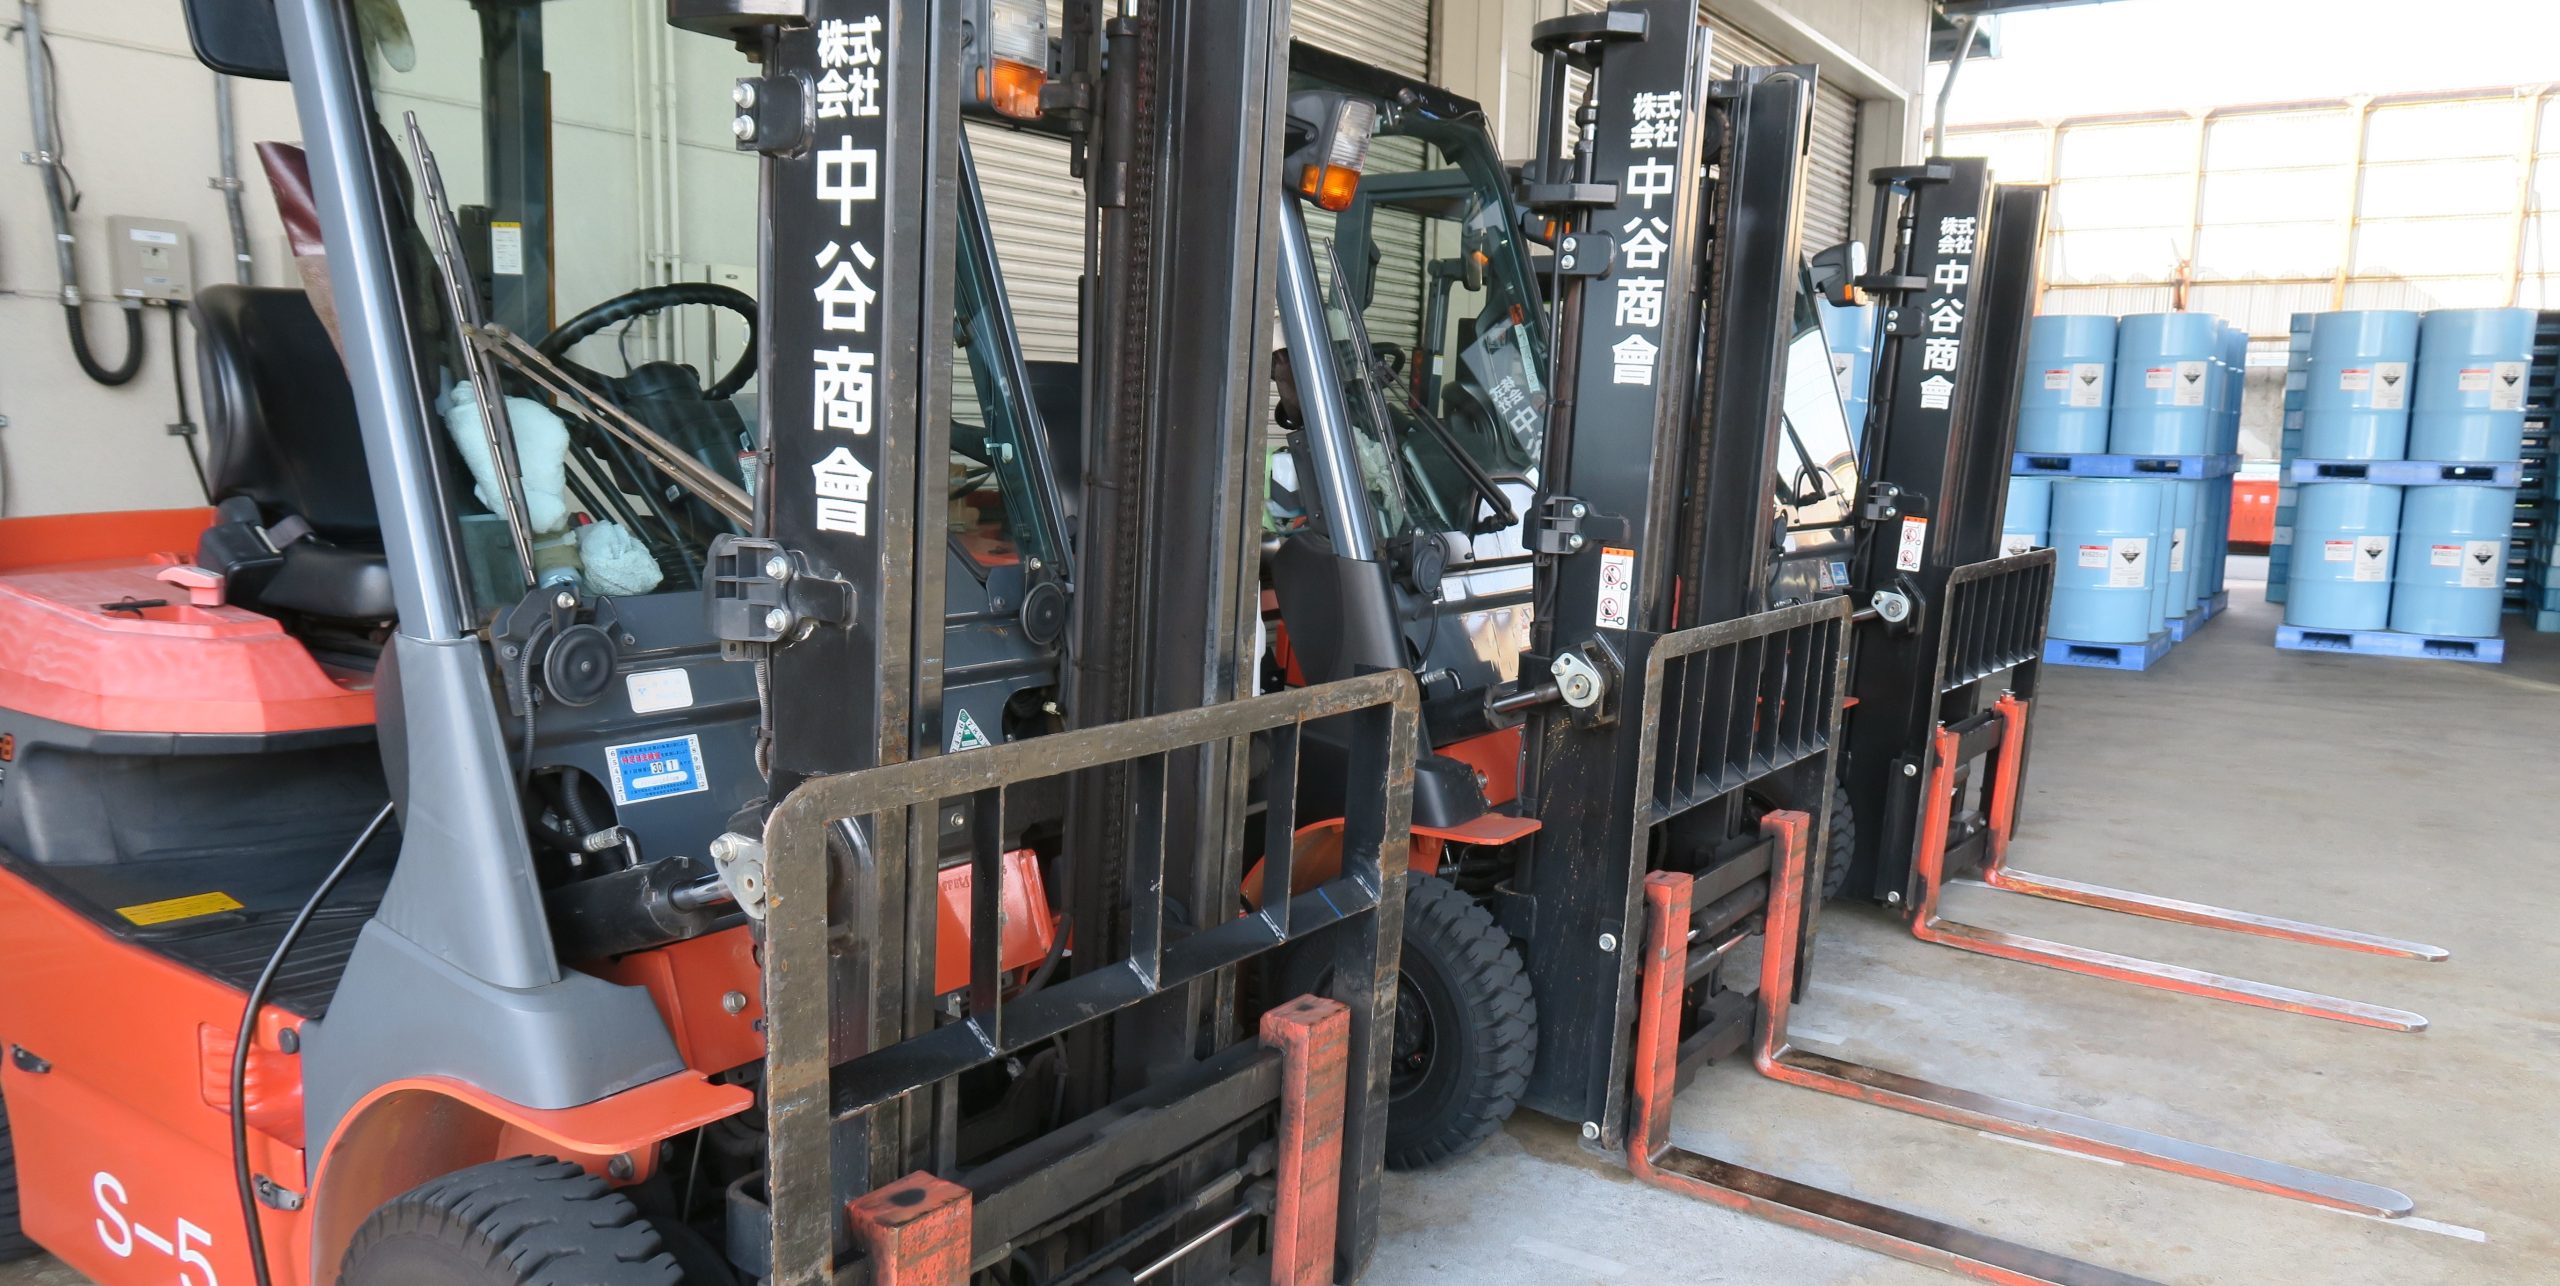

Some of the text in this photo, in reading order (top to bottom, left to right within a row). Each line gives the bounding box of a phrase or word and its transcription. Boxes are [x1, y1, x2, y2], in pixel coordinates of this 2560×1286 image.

[817, 15, 882, 68] 株式
[816, 67, 880, 118] 会社
[1633, 90, 1682, 121] 株式
[1630, 119, 1679, 149] 会社
[1612, 156, 1674, 386] 中谷商會
[812, 134, 878, 537] 中谷商會
[93, 1171, 218, 1286] S-5
